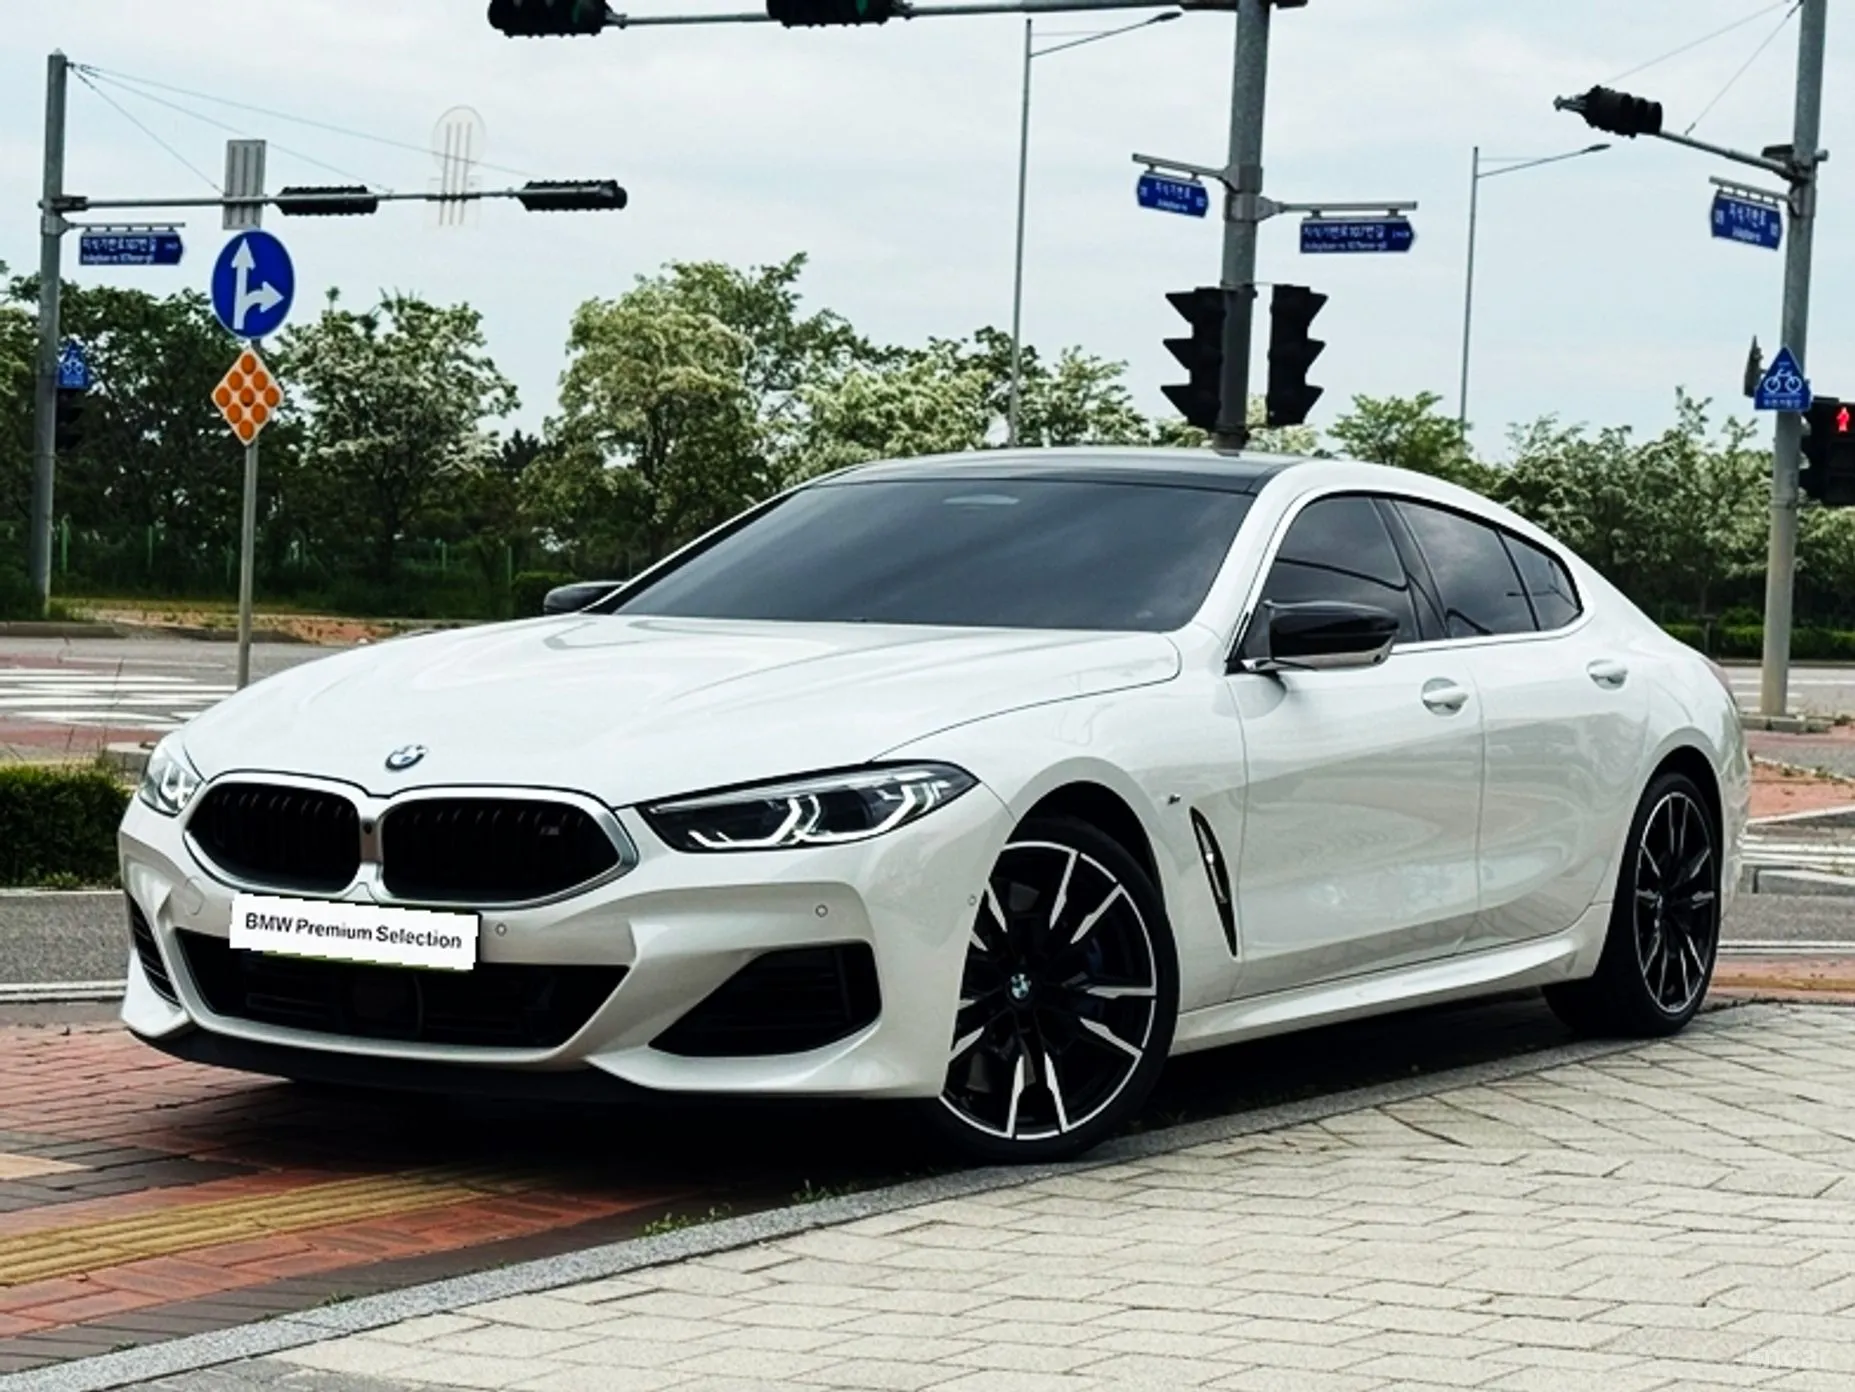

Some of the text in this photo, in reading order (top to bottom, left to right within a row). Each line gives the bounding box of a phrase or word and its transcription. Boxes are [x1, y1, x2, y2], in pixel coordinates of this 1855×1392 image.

[245, 912, 462, 949] BMW Premium Selection
